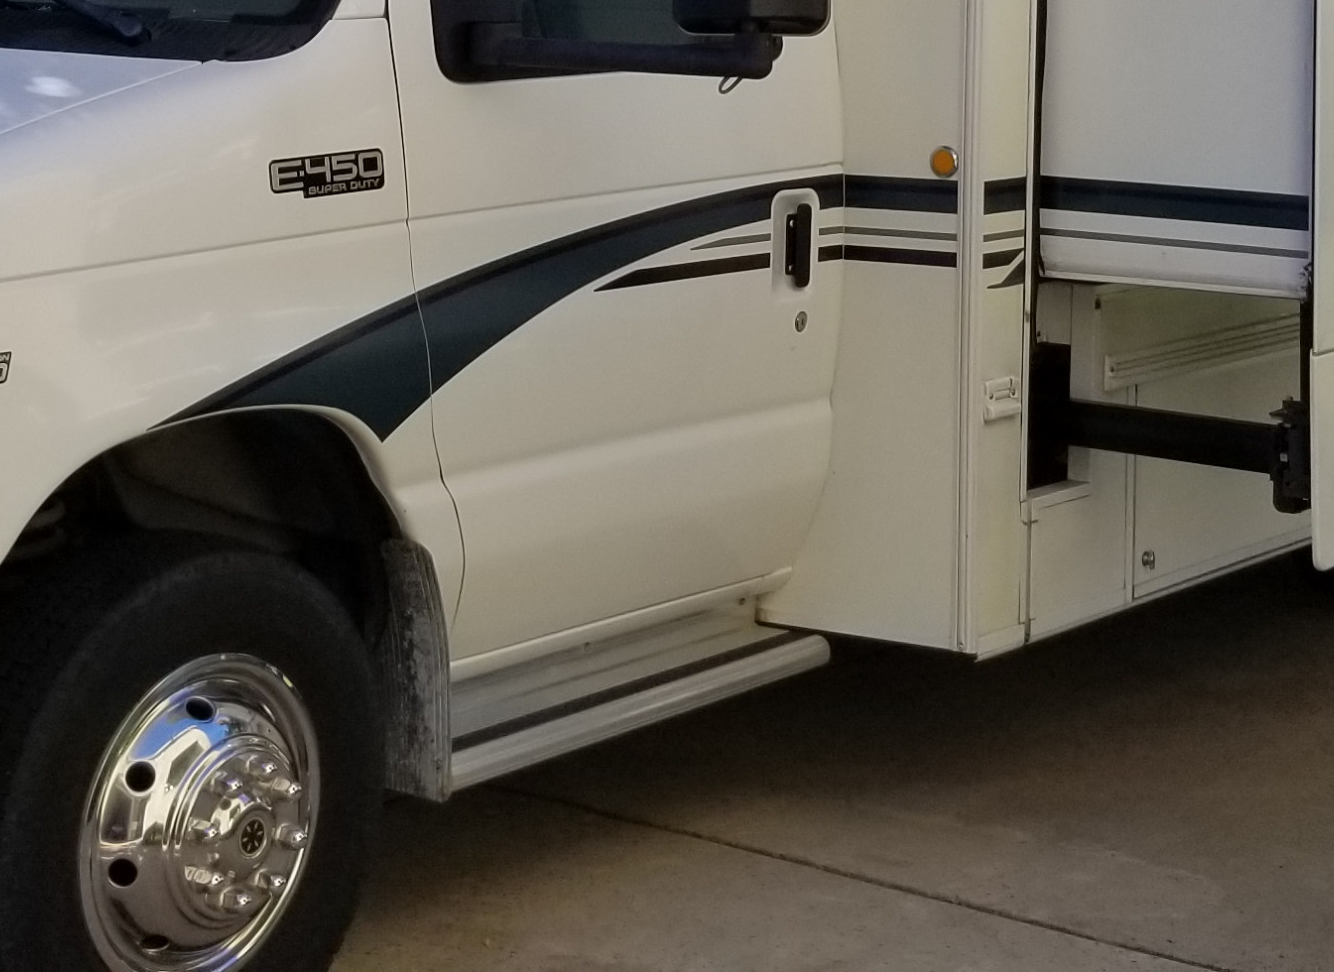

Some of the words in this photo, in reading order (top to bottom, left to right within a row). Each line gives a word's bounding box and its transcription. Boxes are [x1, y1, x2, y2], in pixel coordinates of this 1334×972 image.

[270, 150, 383, 191] E-450
[308, 182, 347, 195] SUPER
[350, 178, 380, 190] DUTY
